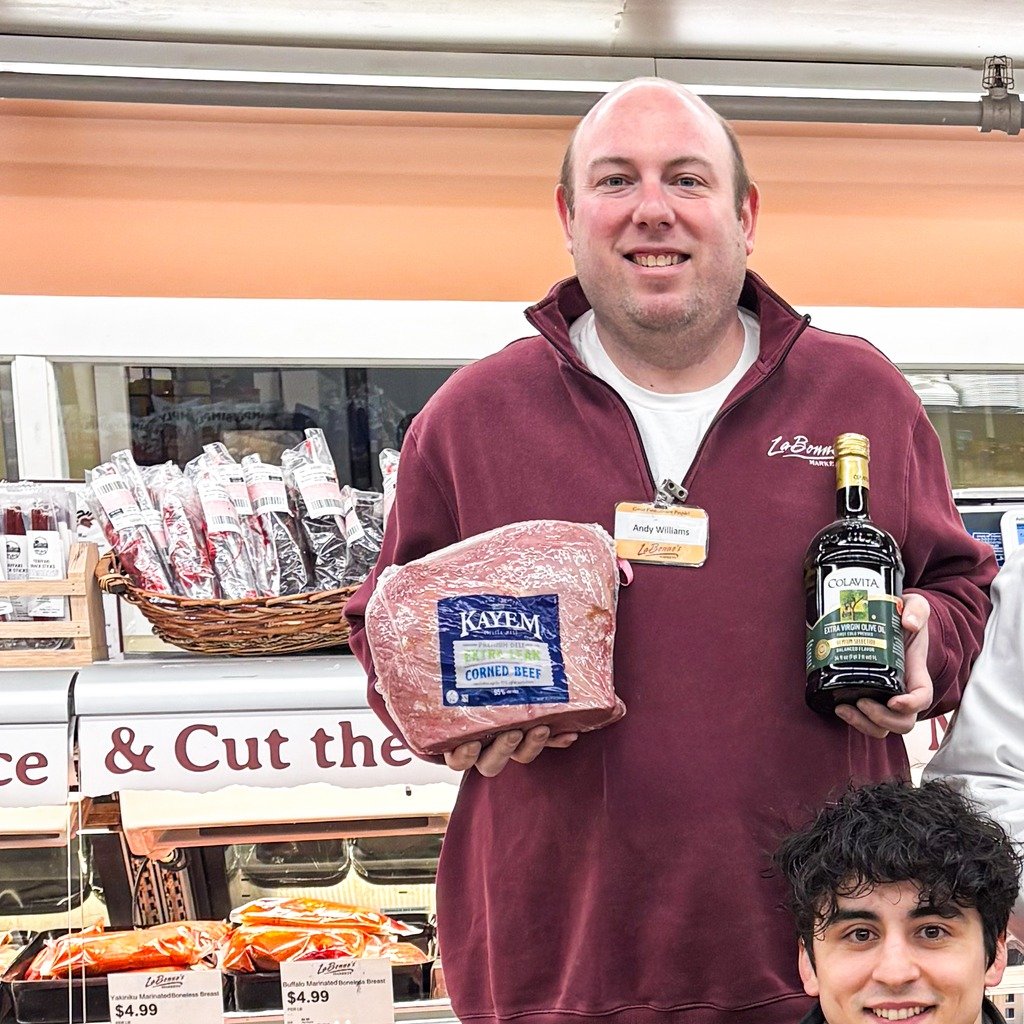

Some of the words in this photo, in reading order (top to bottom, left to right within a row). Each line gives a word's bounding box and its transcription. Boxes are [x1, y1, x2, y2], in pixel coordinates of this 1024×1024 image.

[767, 435, 835, 457] LaBonn
[633, 524, 654, 534] Andy
[656, 526, 690, 536] Williams
[828, 578, 880, 589] COLAVITA
[460, 610, 542, 640] KAYEM
[824, 624, 841, 634] EXTRA
[861, 624, 877, 632] OLIVE
[878, 626, 886, 634] OIL
[465, 665, 508, 681] CORNED
[514, 665, 541, 680] BEEF
[104, 727, 155, 774] &
[175, 724, 290, 772] Cut
[311, 721, 412, 769] the
[317, 961, 357, 975] LaBonne's
[145, 974, 185, 988] LaBonne's
[287, 989, 329, 1005] $4.99
[115, 1003, 158, 1018] $4.99
